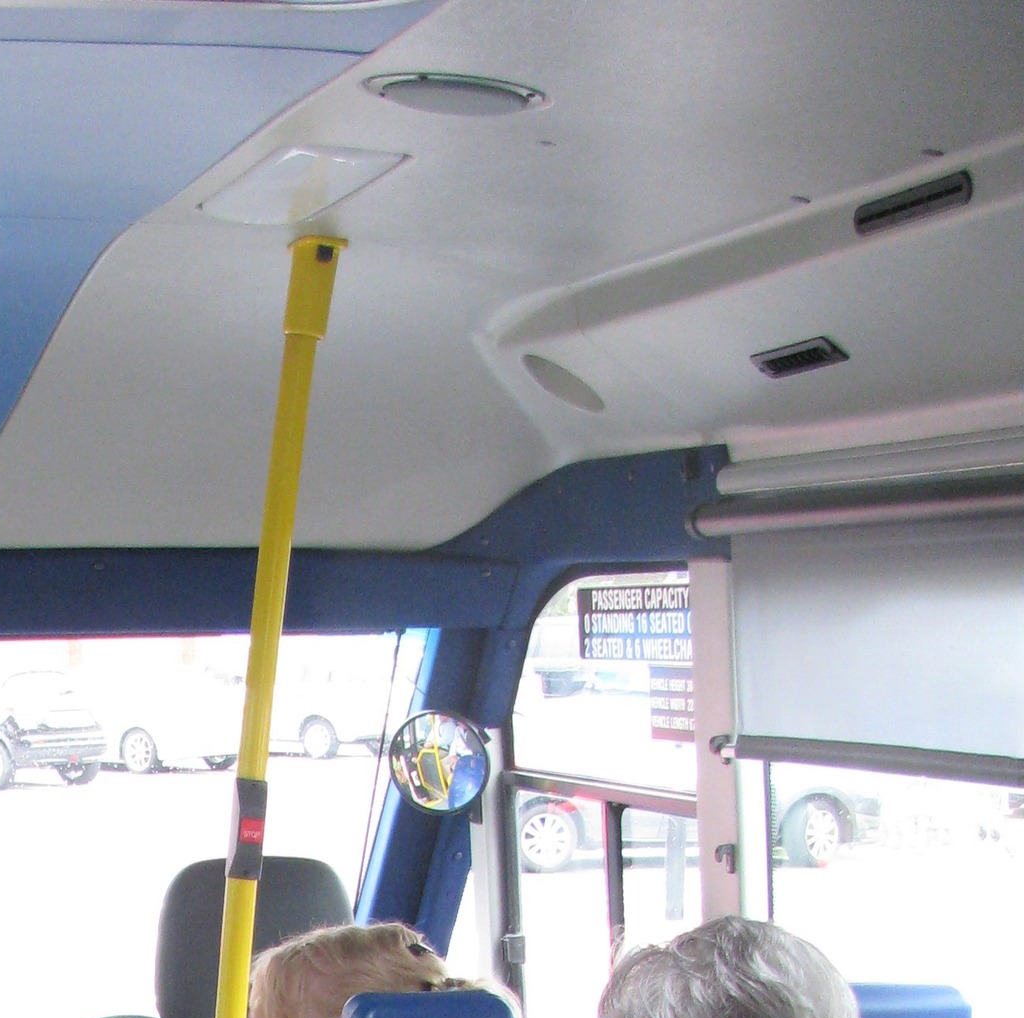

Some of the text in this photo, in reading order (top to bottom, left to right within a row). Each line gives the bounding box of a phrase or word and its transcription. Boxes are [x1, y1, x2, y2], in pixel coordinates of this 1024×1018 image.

[591, 587, 689, 611] PASSENGER CAPACITY
[591, 612, 635, 634] STANDING
[636, 612, 648, 634] 16
[649, 612, 685, 634] SEATED
[584, 637, 591, 658] 2
[591, 637, 624, 658] SEATED
[626, 638, 633, 658] &
[634, 638, 641, 658] 6
[650, 678, 669, 691] VEHICLE
[669, 679, 686, 692] HEIGHT
[650, 697, 669, 710] VEHICLE
[651, 715, 670, 728] VEHICLE
[670, 717, 688, 730] LENGTH
[244, 831, 261, 839] STOP
